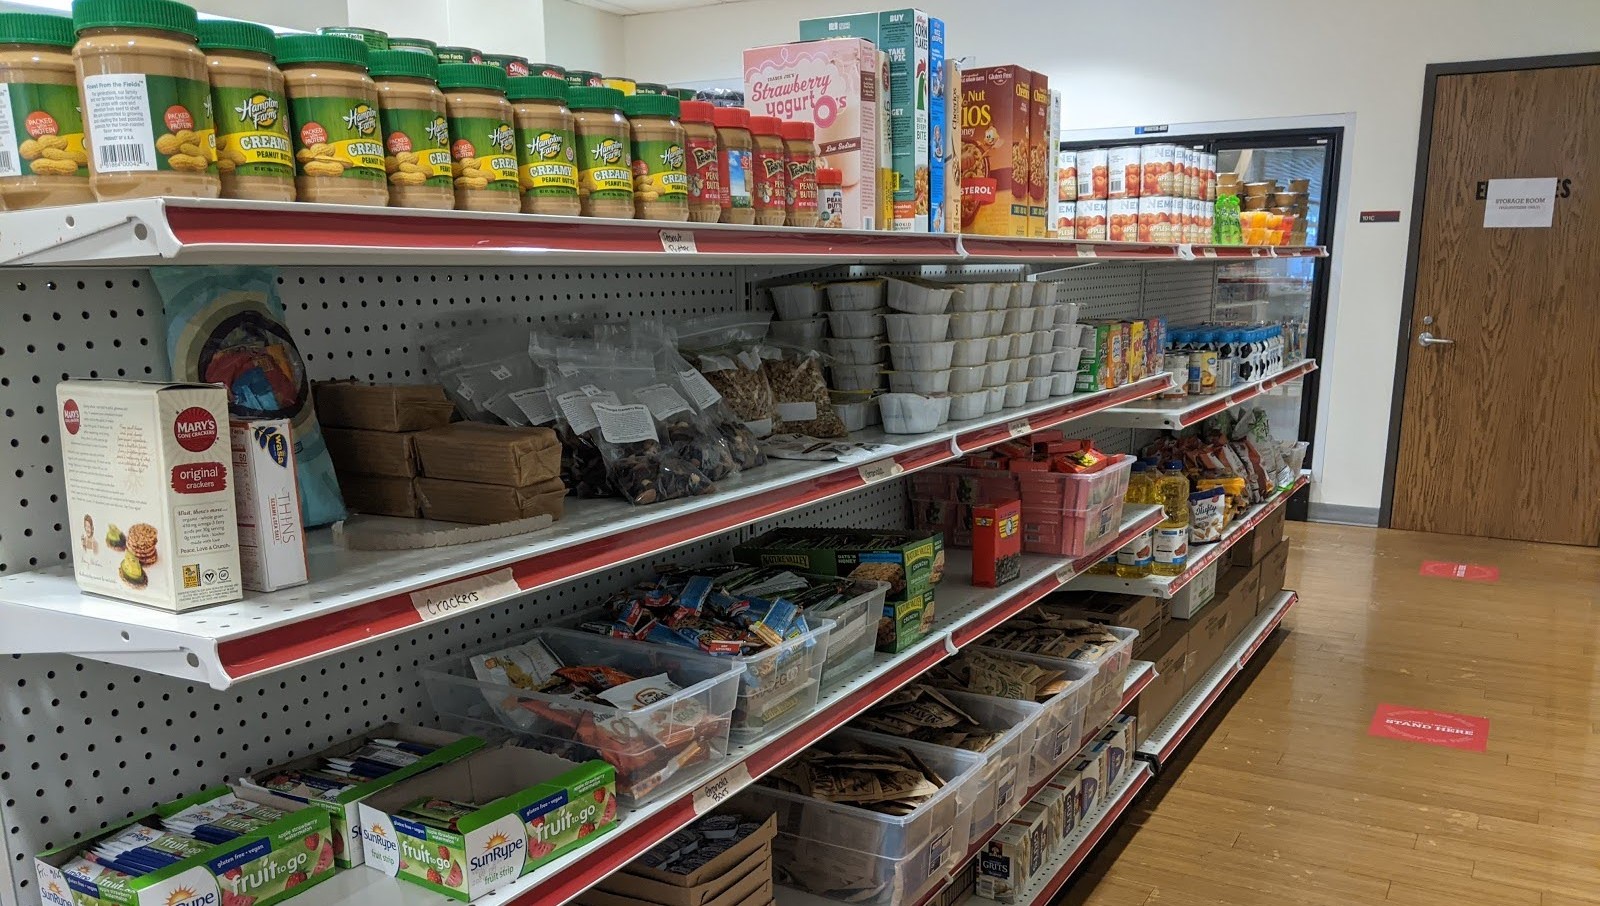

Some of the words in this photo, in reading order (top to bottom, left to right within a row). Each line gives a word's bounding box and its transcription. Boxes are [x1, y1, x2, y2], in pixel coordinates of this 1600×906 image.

[889, 14, 904, 22] BUY
[915, 23, 928, 38] CORN
[751, 74, 831, 102] Strawberry
[968, 90, 985, 101] Nut
[238, 97, 278, 121] Hampton
[766, 91, 815, 119] yogurt
[916, 131, 926, 140] BITE
[256, 150, 279, 159] PEANUT
[347, 143, 384, 156] CREAM
[529, 164, 573, 177] CREAMY
[960, 186, 991, 195] STEROL
[177, 419, 215, 433] MARY'S
[178, 432, 190, 440] GONE
[190, 430, 215, 438] CRACKERS
[179, 467, 219, 482] original
[186, 481, 215, 489] crackers
[278, 491, 296, 544] THINS
[426, 591, 479, 615] Crackers
[1385, 719, 1432, 730] STAND
[1435, 726, 1474, 736] HERE
[536, 808, 573, 843] fruit
[572, 815, 579, 823] to
[579, 805, 596, 823] go
[363, 829, 397, 852] SunRype
[217, 856, 234, 869] gluten
[234, 851, 245, 862] free
[248, 844, 264, 855] vegan
[371, 848, 382, 859] fruit
[382, 854, 395, 865] strip
[402, 841, 431, 863] fruit
[437, 857, 451, 870] go
[470, 838, 523, 871] SunRype
[231, 857, 278, 897] fruit
[277, 864, 286, 875] to
[287, 852, 307, 875] go
[484, 871, 499, 886] fruit
[499, 864, 514, 881] strip
[982, 860, 1008, 873] GRITS
